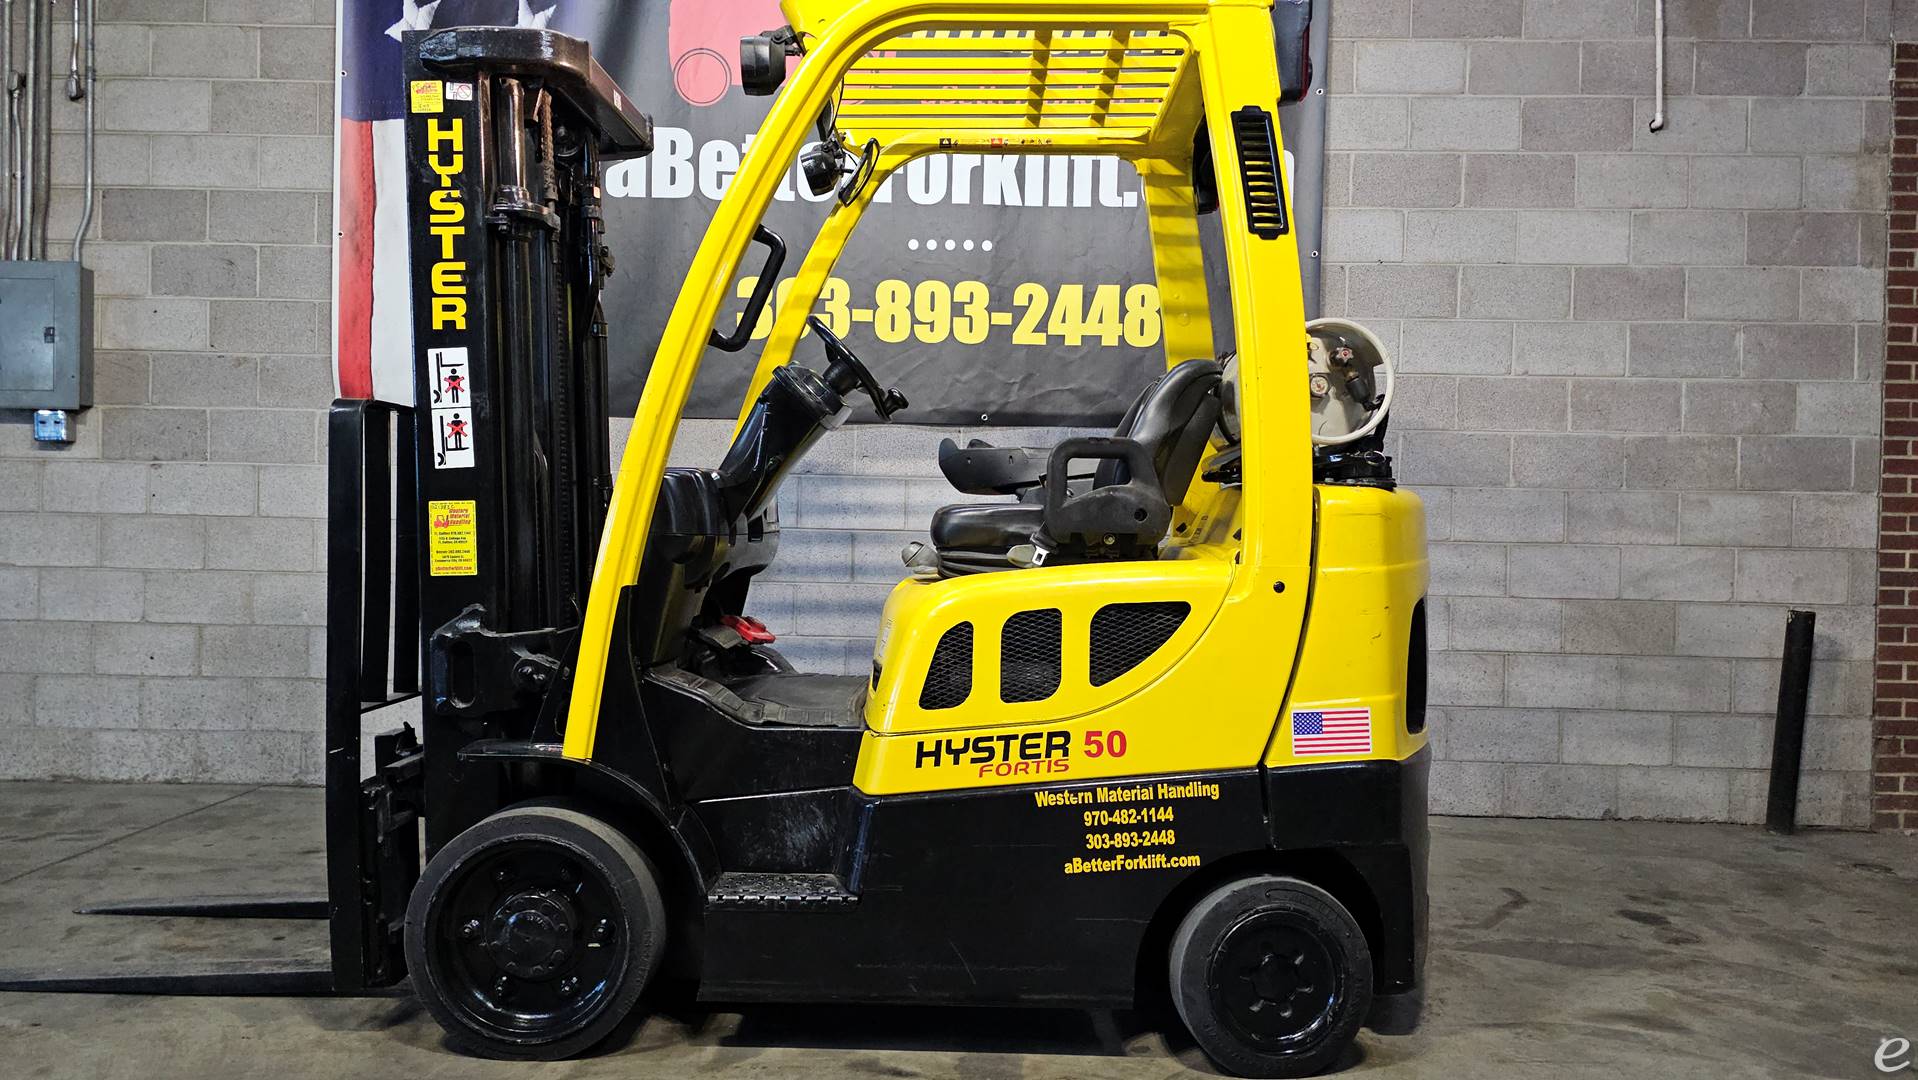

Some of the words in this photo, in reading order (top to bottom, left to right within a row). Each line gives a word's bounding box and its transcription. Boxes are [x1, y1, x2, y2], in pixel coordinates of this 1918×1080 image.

[427, 118, 467, 330] HYSTER
[736, 275, 1161, 348] 33-893-2448
[915, 730, 1071, 768] HYSTER
[1083, 730, 1127, 758] 50
[978, 758, 1069, 778] FORTIS
[1035, 790, 1093, 808] Western
[1097, 786, 1153, 804] Material
[1157, 781, 1220, 800] Handling
[1083, 806, 1174, 827] 970-482-1144
[1085, 829, 1176, 850] 303-893-2448
[1064, 853, 1201, 875] aBetterForklift.com
